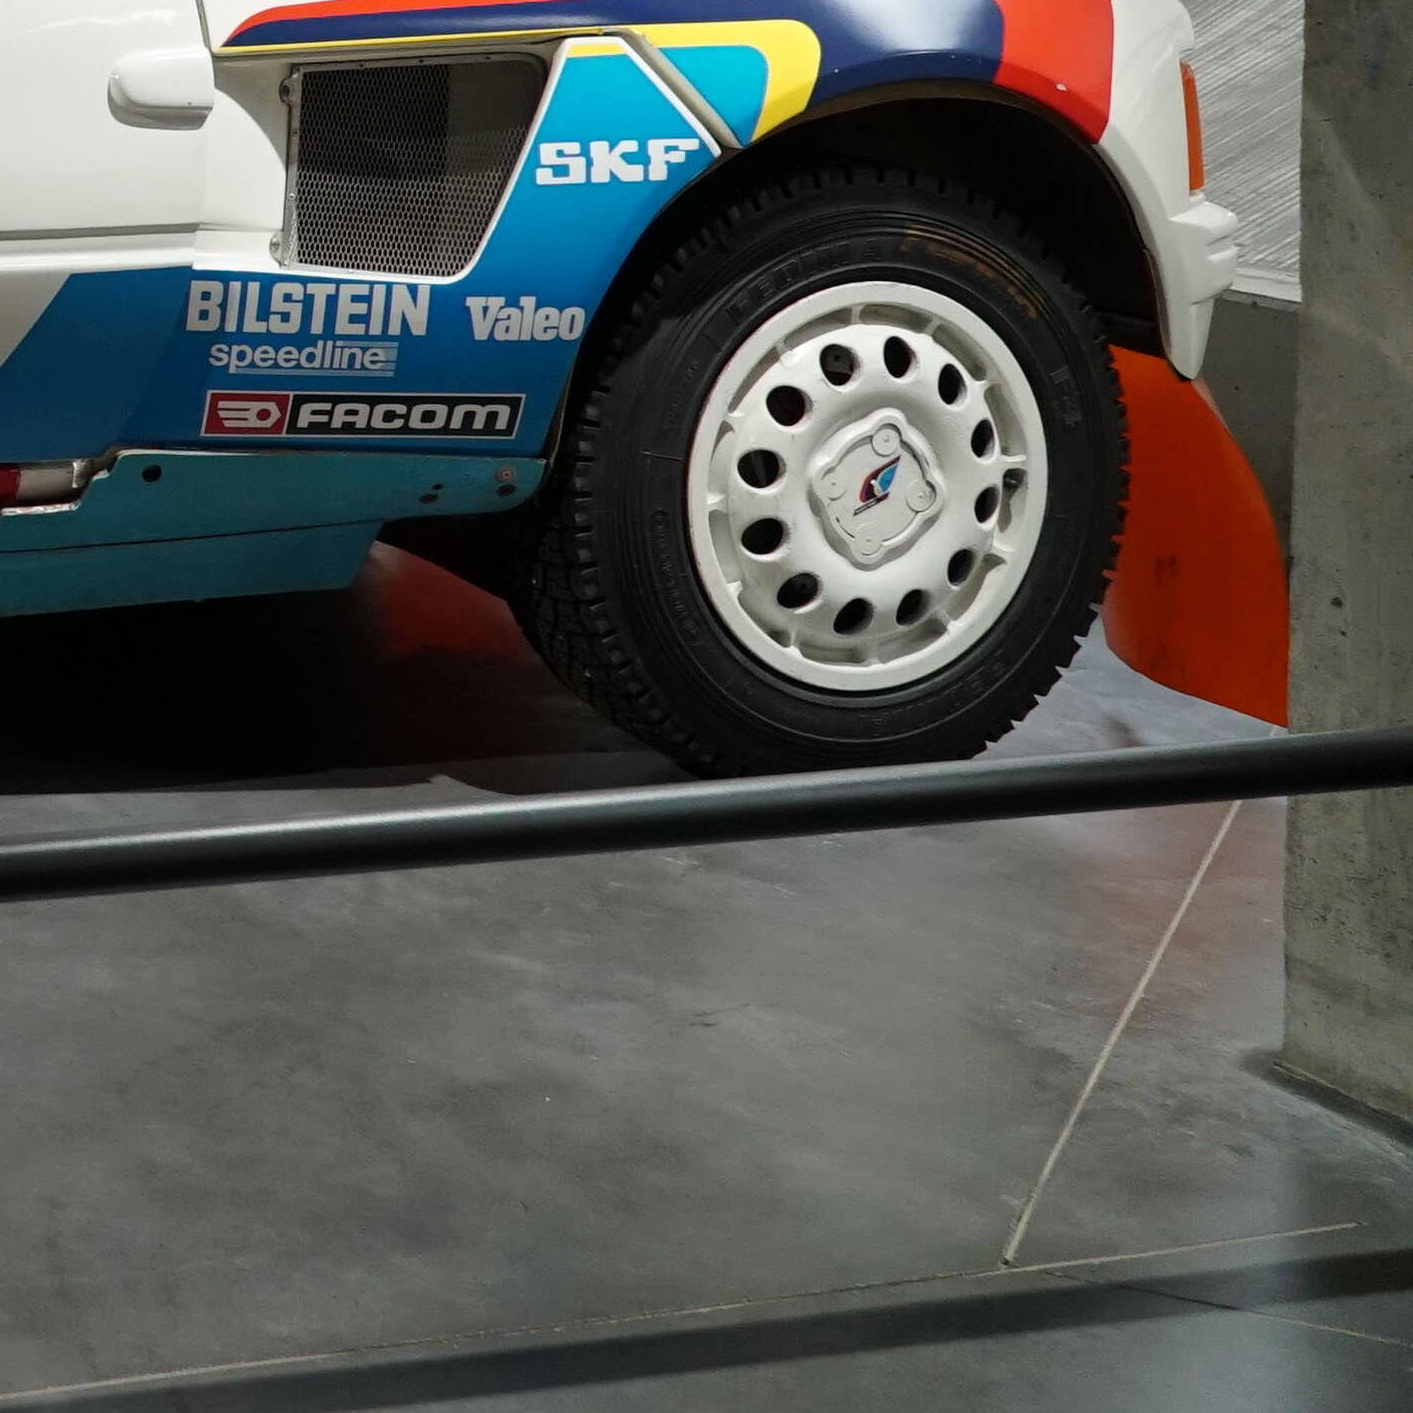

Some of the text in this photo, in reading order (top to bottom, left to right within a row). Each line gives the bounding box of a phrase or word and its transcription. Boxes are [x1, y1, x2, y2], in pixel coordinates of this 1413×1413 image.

[535, 138, 700, 186] SKF
[185, 279, 431, 336] BILSTEIN
[466, 295, 586, 341] Valeo
[209, 339, 387, 375] speedline
[296, 402, 511, 430] FACOM
